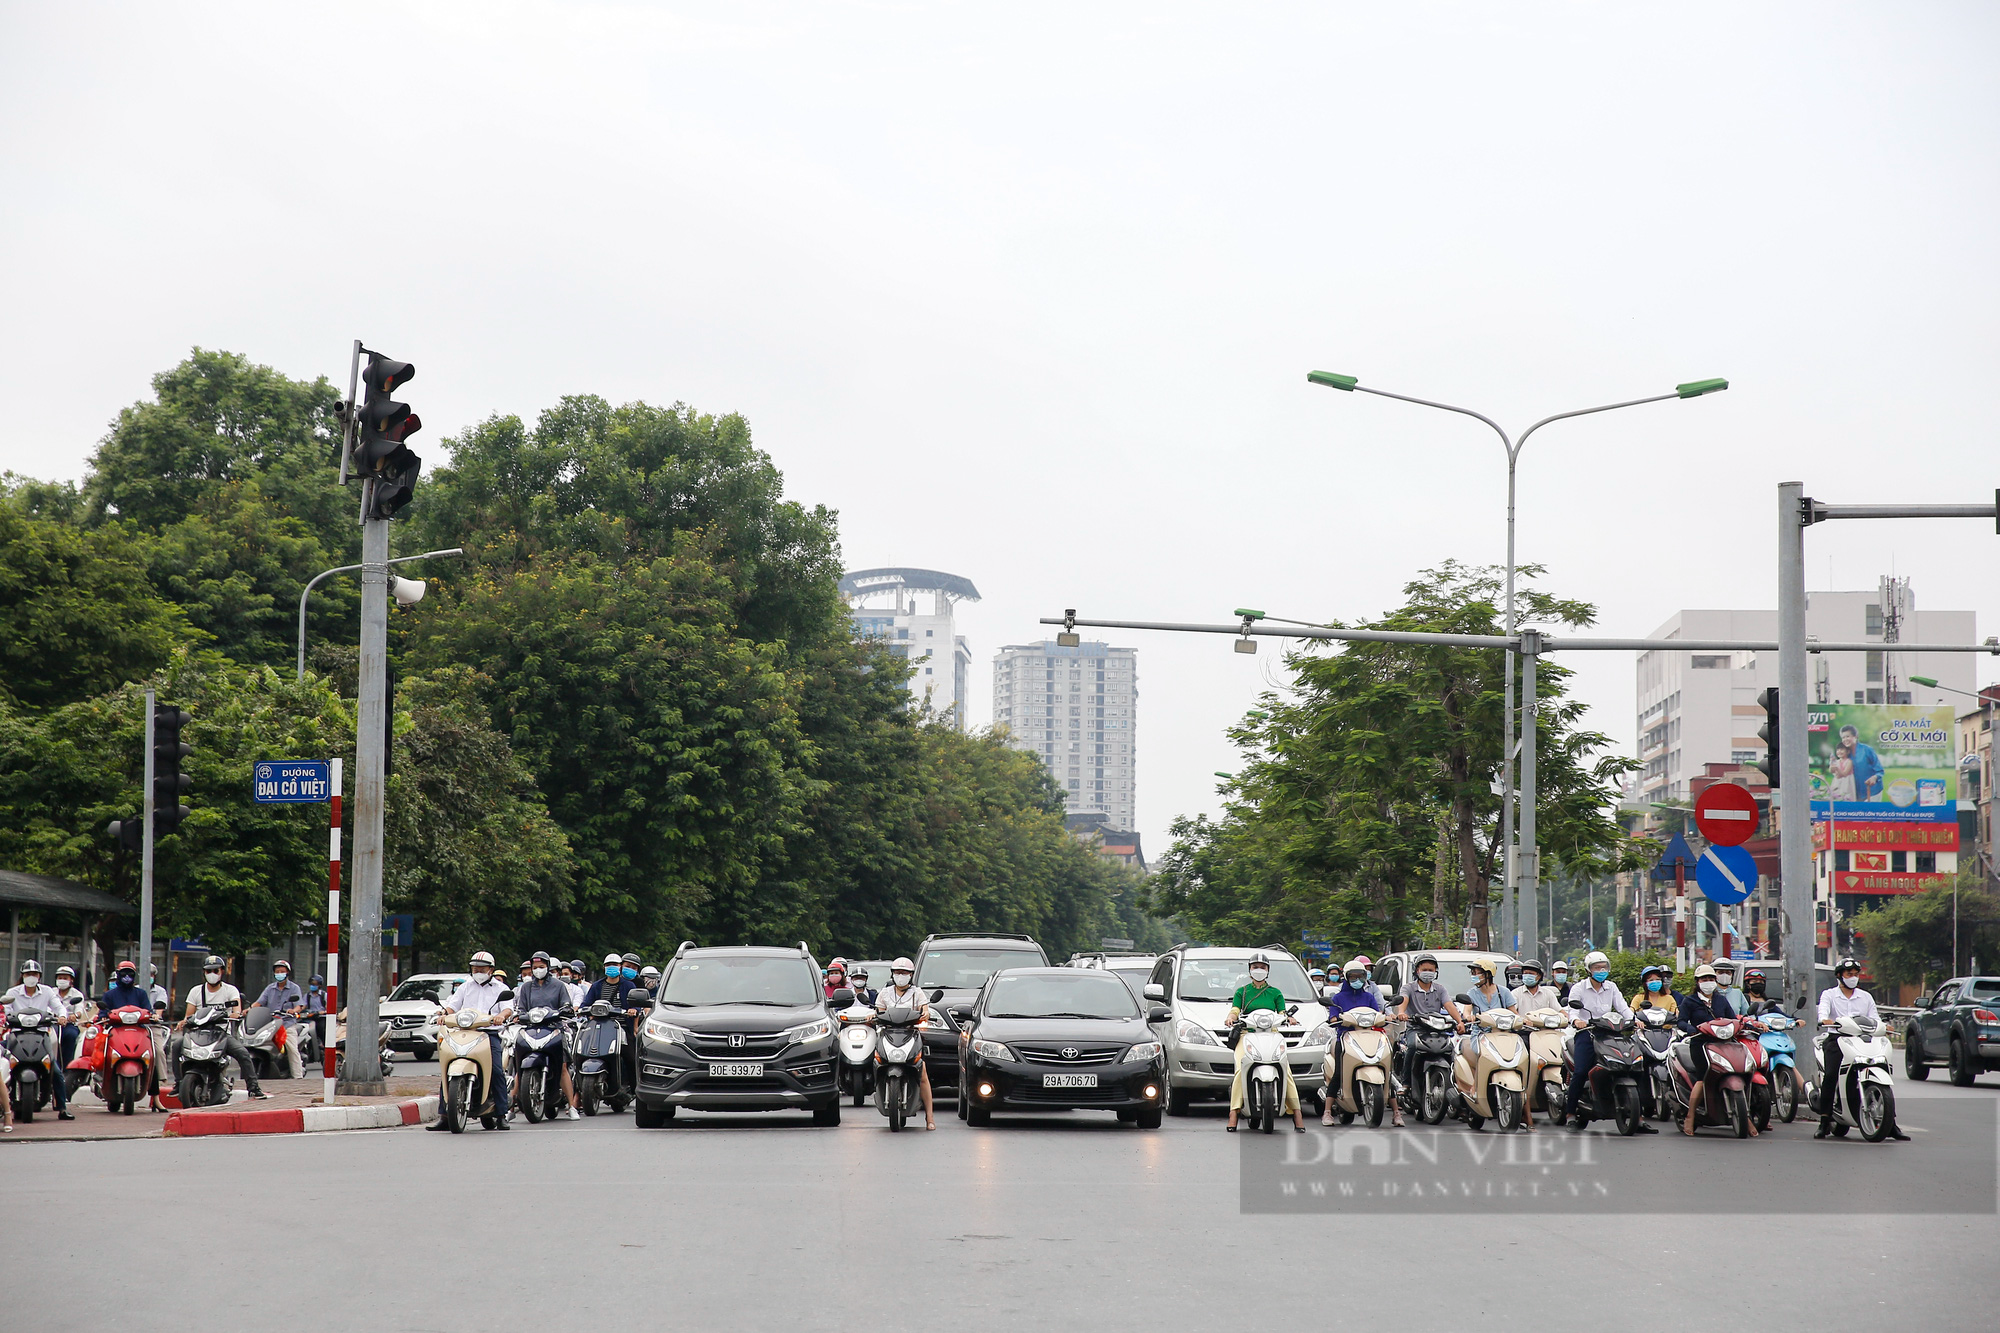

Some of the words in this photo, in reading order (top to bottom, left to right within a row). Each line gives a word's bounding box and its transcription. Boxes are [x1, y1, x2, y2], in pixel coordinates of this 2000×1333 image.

[1894, 720, 1907, 728] RA
[1910, 717, 1931, 728] MẮT
[1880, 729, 1899, 741] CỠ
[1902, 732, 1917, 741] XL
[1920, 729, 1947, 742] MỚI
[282, 767, 316, 777] ĐƯỜNG
[258, 781, 278, 799] ĐẠI
[300, 778, 325, 798] VIỆT
[1864, 875, 1889, 888] VÀNG
